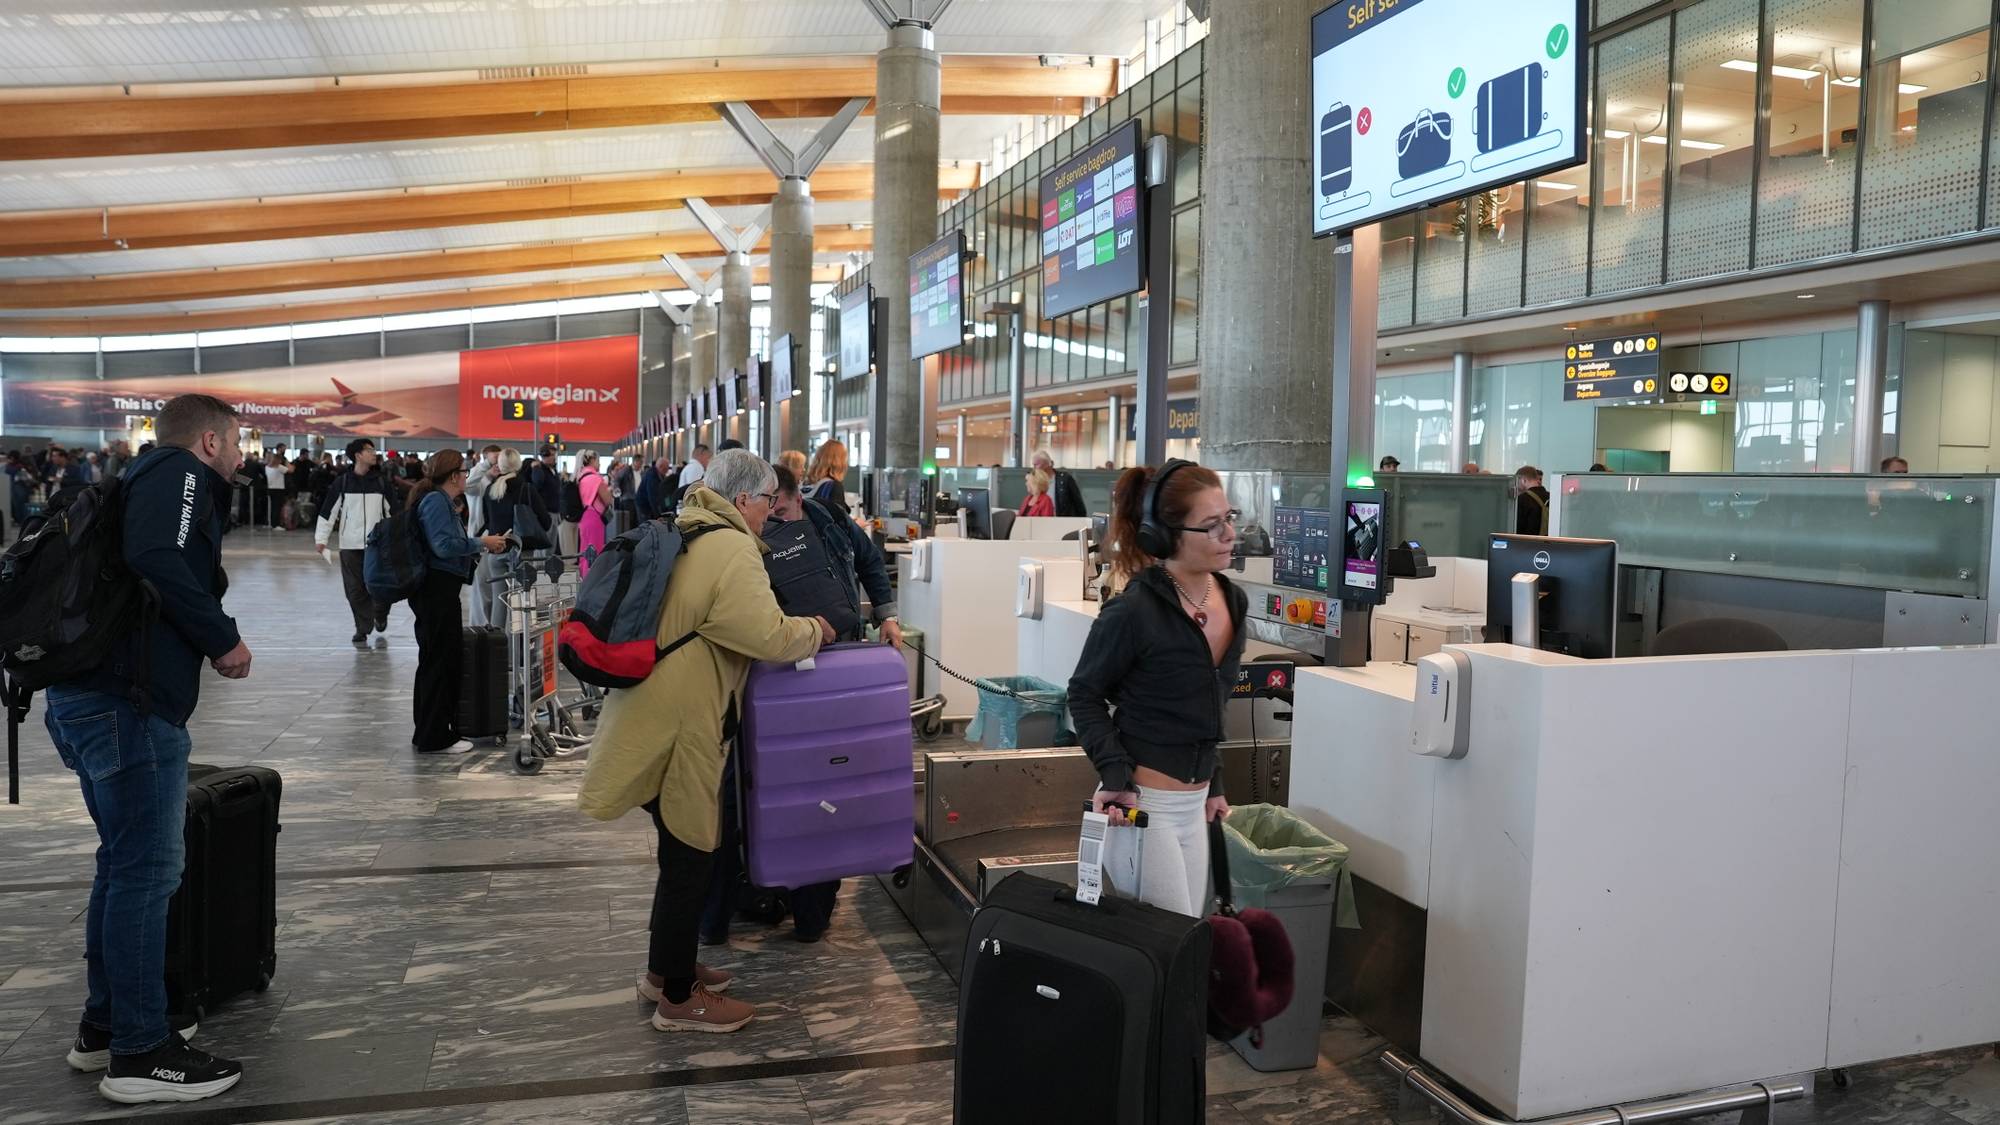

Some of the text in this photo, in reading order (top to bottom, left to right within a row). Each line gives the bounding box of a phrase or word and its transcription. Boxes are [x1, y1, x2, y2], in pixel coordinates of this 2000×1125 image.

[1347, 0, 1375, 29] Self
[1055, 146, 1116, 191] Self service bagdrop
[1118, 230, 1133, 249] LOT
[482, 383, 596, 405] norwegian
[111, 397, 140, 410] This
[141, 398, 153, 410] is
[245, 402, 317, 418] Norwegian
[513, 402, 524, 418] 3
[142, 416, 152, 431] 2
[177, 472, 196, 548] HELLY HANSEN
[150, 1067, 186, 1082] HOKA
